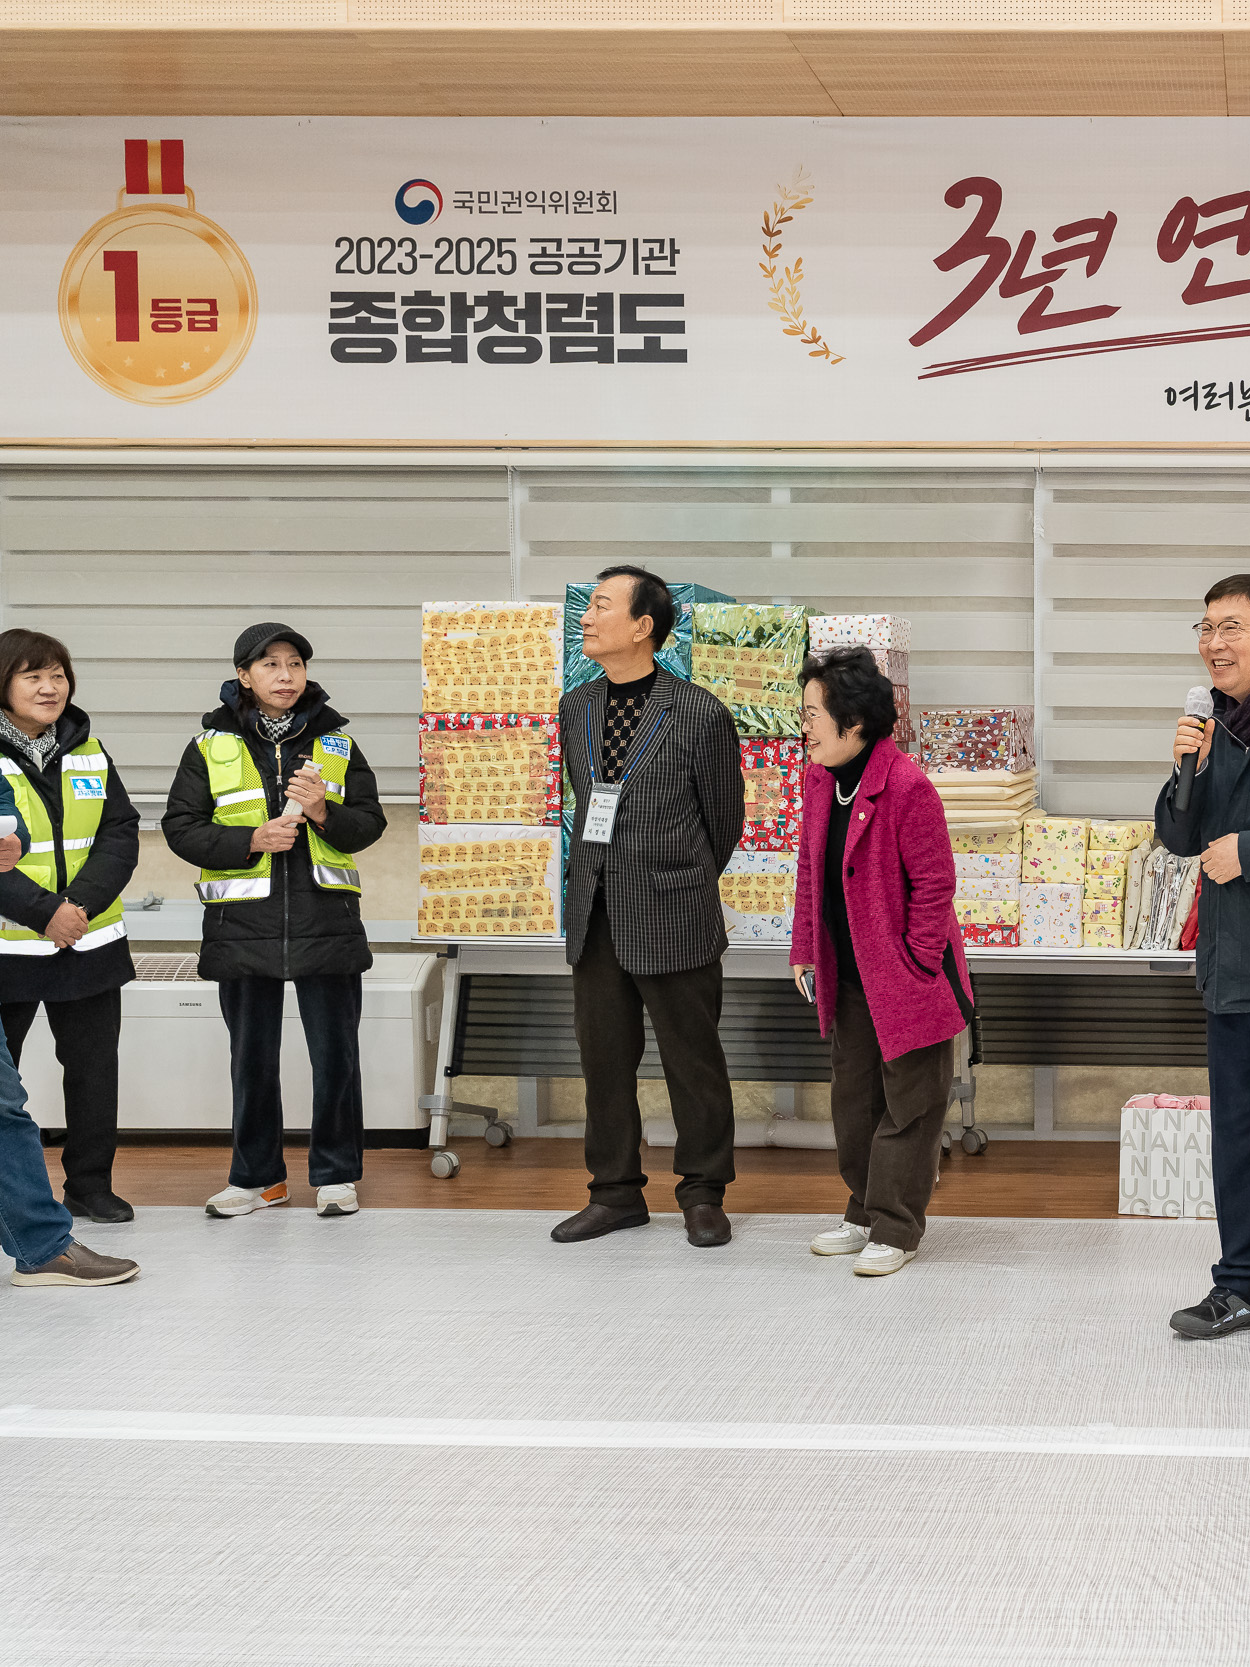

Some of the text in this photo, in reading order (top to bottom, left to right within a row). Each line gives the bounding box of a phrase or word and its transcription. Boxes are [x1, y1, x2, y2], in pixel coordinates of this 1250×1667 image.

[453, 190, 617, 215] 국민권익위원회
[334, 236, 681, 276] 2023-2025 공공기관
[908, 176, 1122, 347] 3년
[103, 250, 219, 342] 1등급
[328, 289, 688, 365] 종합청렴도
